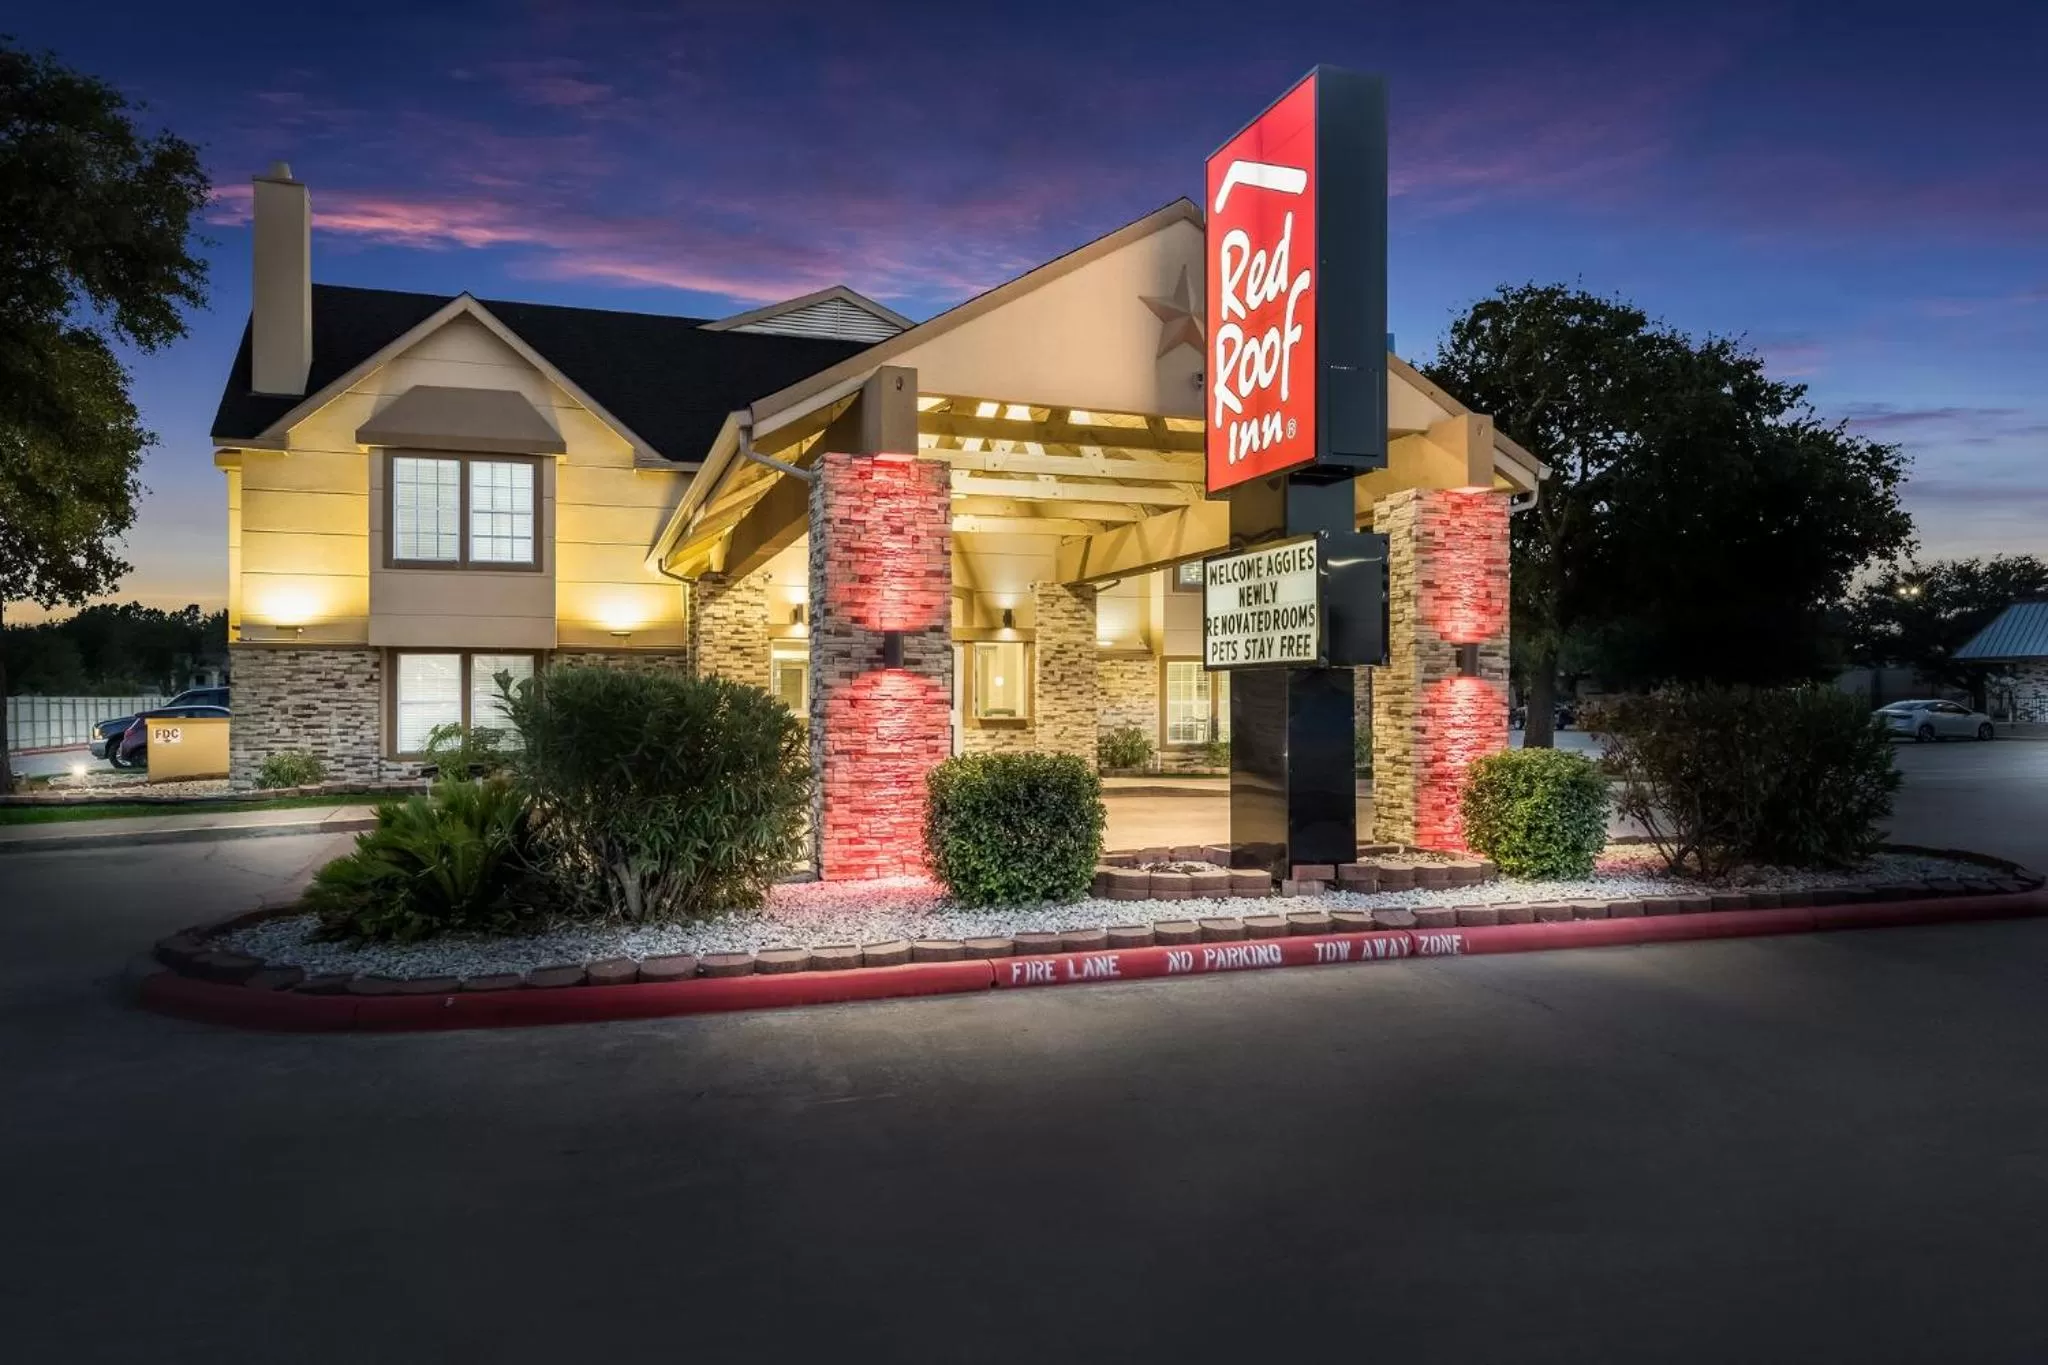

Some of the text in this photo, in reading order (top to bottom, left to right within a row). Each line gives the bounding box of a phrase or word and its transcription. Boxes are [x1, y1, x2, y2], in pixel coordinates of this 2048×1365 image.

[1220, 210, 1294, 322] Red
[1214, 268, 1312, 429] Roof
[1209, 545, 1315, 587] WELCOME AGGIES
[1238, 581, 1279, 608] NEWLY
[1207, 603, 1316, 637] RENOVATED ROOMS
[1211, 633, 1312, 662] PETS STAY FREE
[155, 728, 179, 739] FDC
[1011, 934, 1463, 984] FIRE LANE NO PARKING TOW AWAY ZONE
